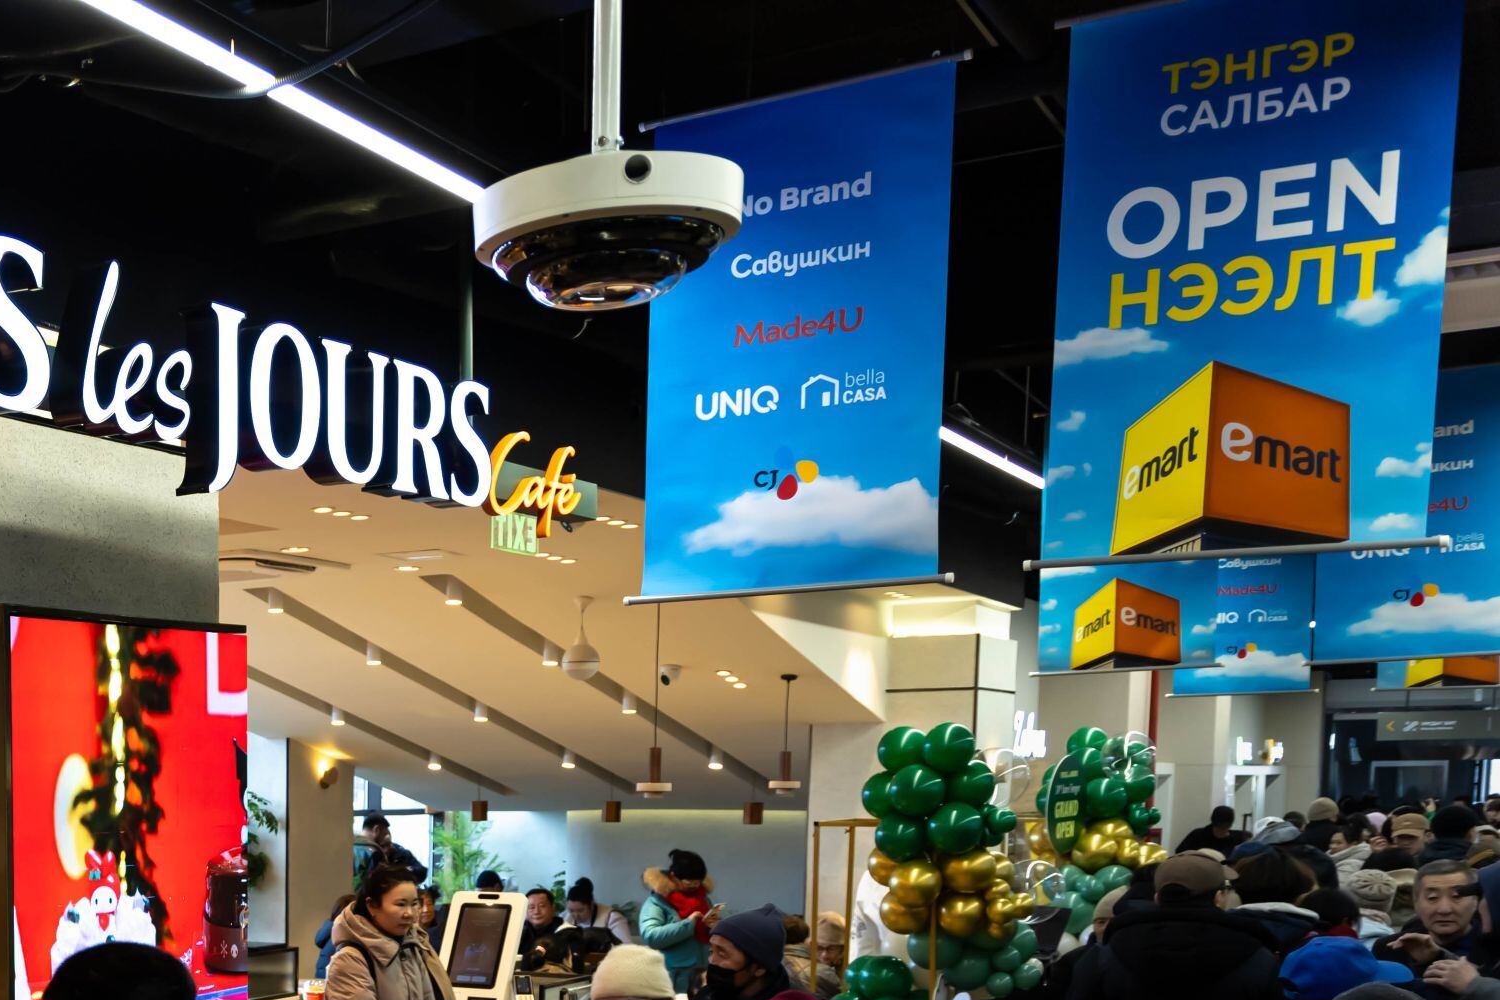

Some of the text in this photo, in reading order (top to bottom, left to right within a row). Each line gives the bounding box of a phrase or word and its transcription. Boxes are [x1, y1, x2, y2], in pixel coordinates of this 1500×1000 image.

[1161, 32, 1355, 94] ТЭНГЭР
[1160, 76, 1351, 137] САЛБАР
[780, 171, 872, 211] Brand
[1106, 149, 1401, 260] OPEN
[730, 240, 871, 279] Савушкин
[1108, 237, 1396, 330] НЭЭЛТ
[733, 306, 864, 347] Made4U
[81, 258, 193, 442] les
[208, 301, 493, 508] JOURS
[842, 387, 887, 404] CASA
[844, 368, 885, 388] bella
[695, 385, 779, 421] UNIQ
[1433, 419, 1474, 438] and
[1123, 427, 1199, 499] emart
[1221, 421, 1341, 483] emart
[754, 469, 779, 491] CJ
[1455, 542, 1486, 552] CASA
[1075, 609, 1111, 643] emart
[1121, 606, 1177, 636] emart
[1054, 799, 1079, 819] GRAND
[1055, 820, 1075, 839] OPEN
